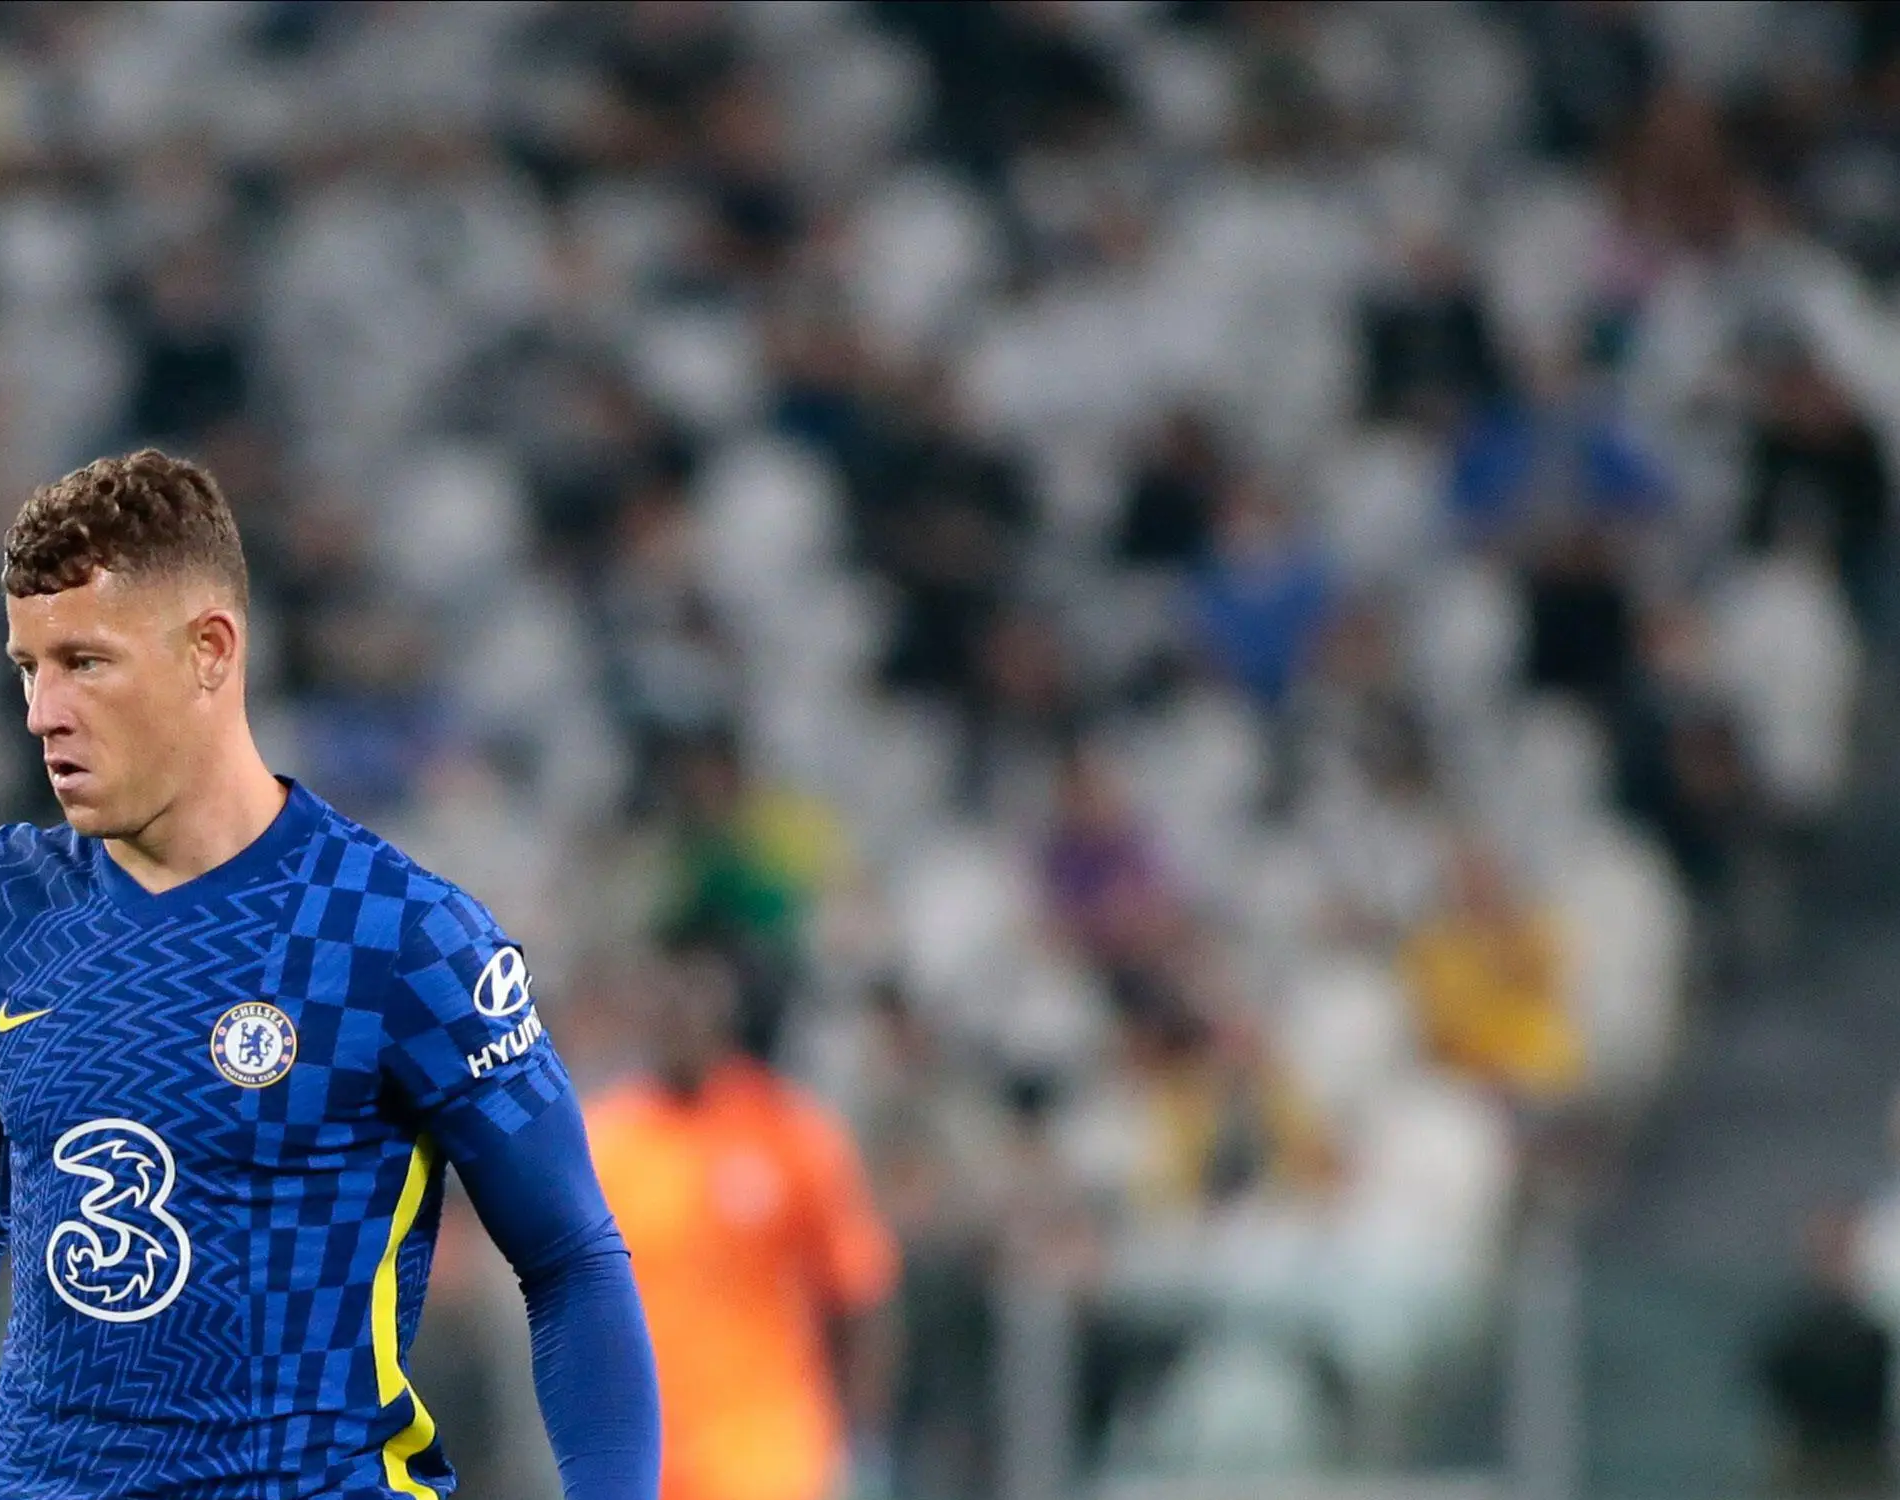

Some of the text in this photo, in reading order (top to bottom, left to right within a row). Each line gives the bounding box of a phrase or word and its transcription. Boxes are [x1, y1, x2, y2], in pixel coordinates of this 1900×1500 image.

[231, 1006, 284, 1029] CHELSEA
[467, 1004, 542, 1079] HYUN
[47, 1117, 192, 1323] 3
